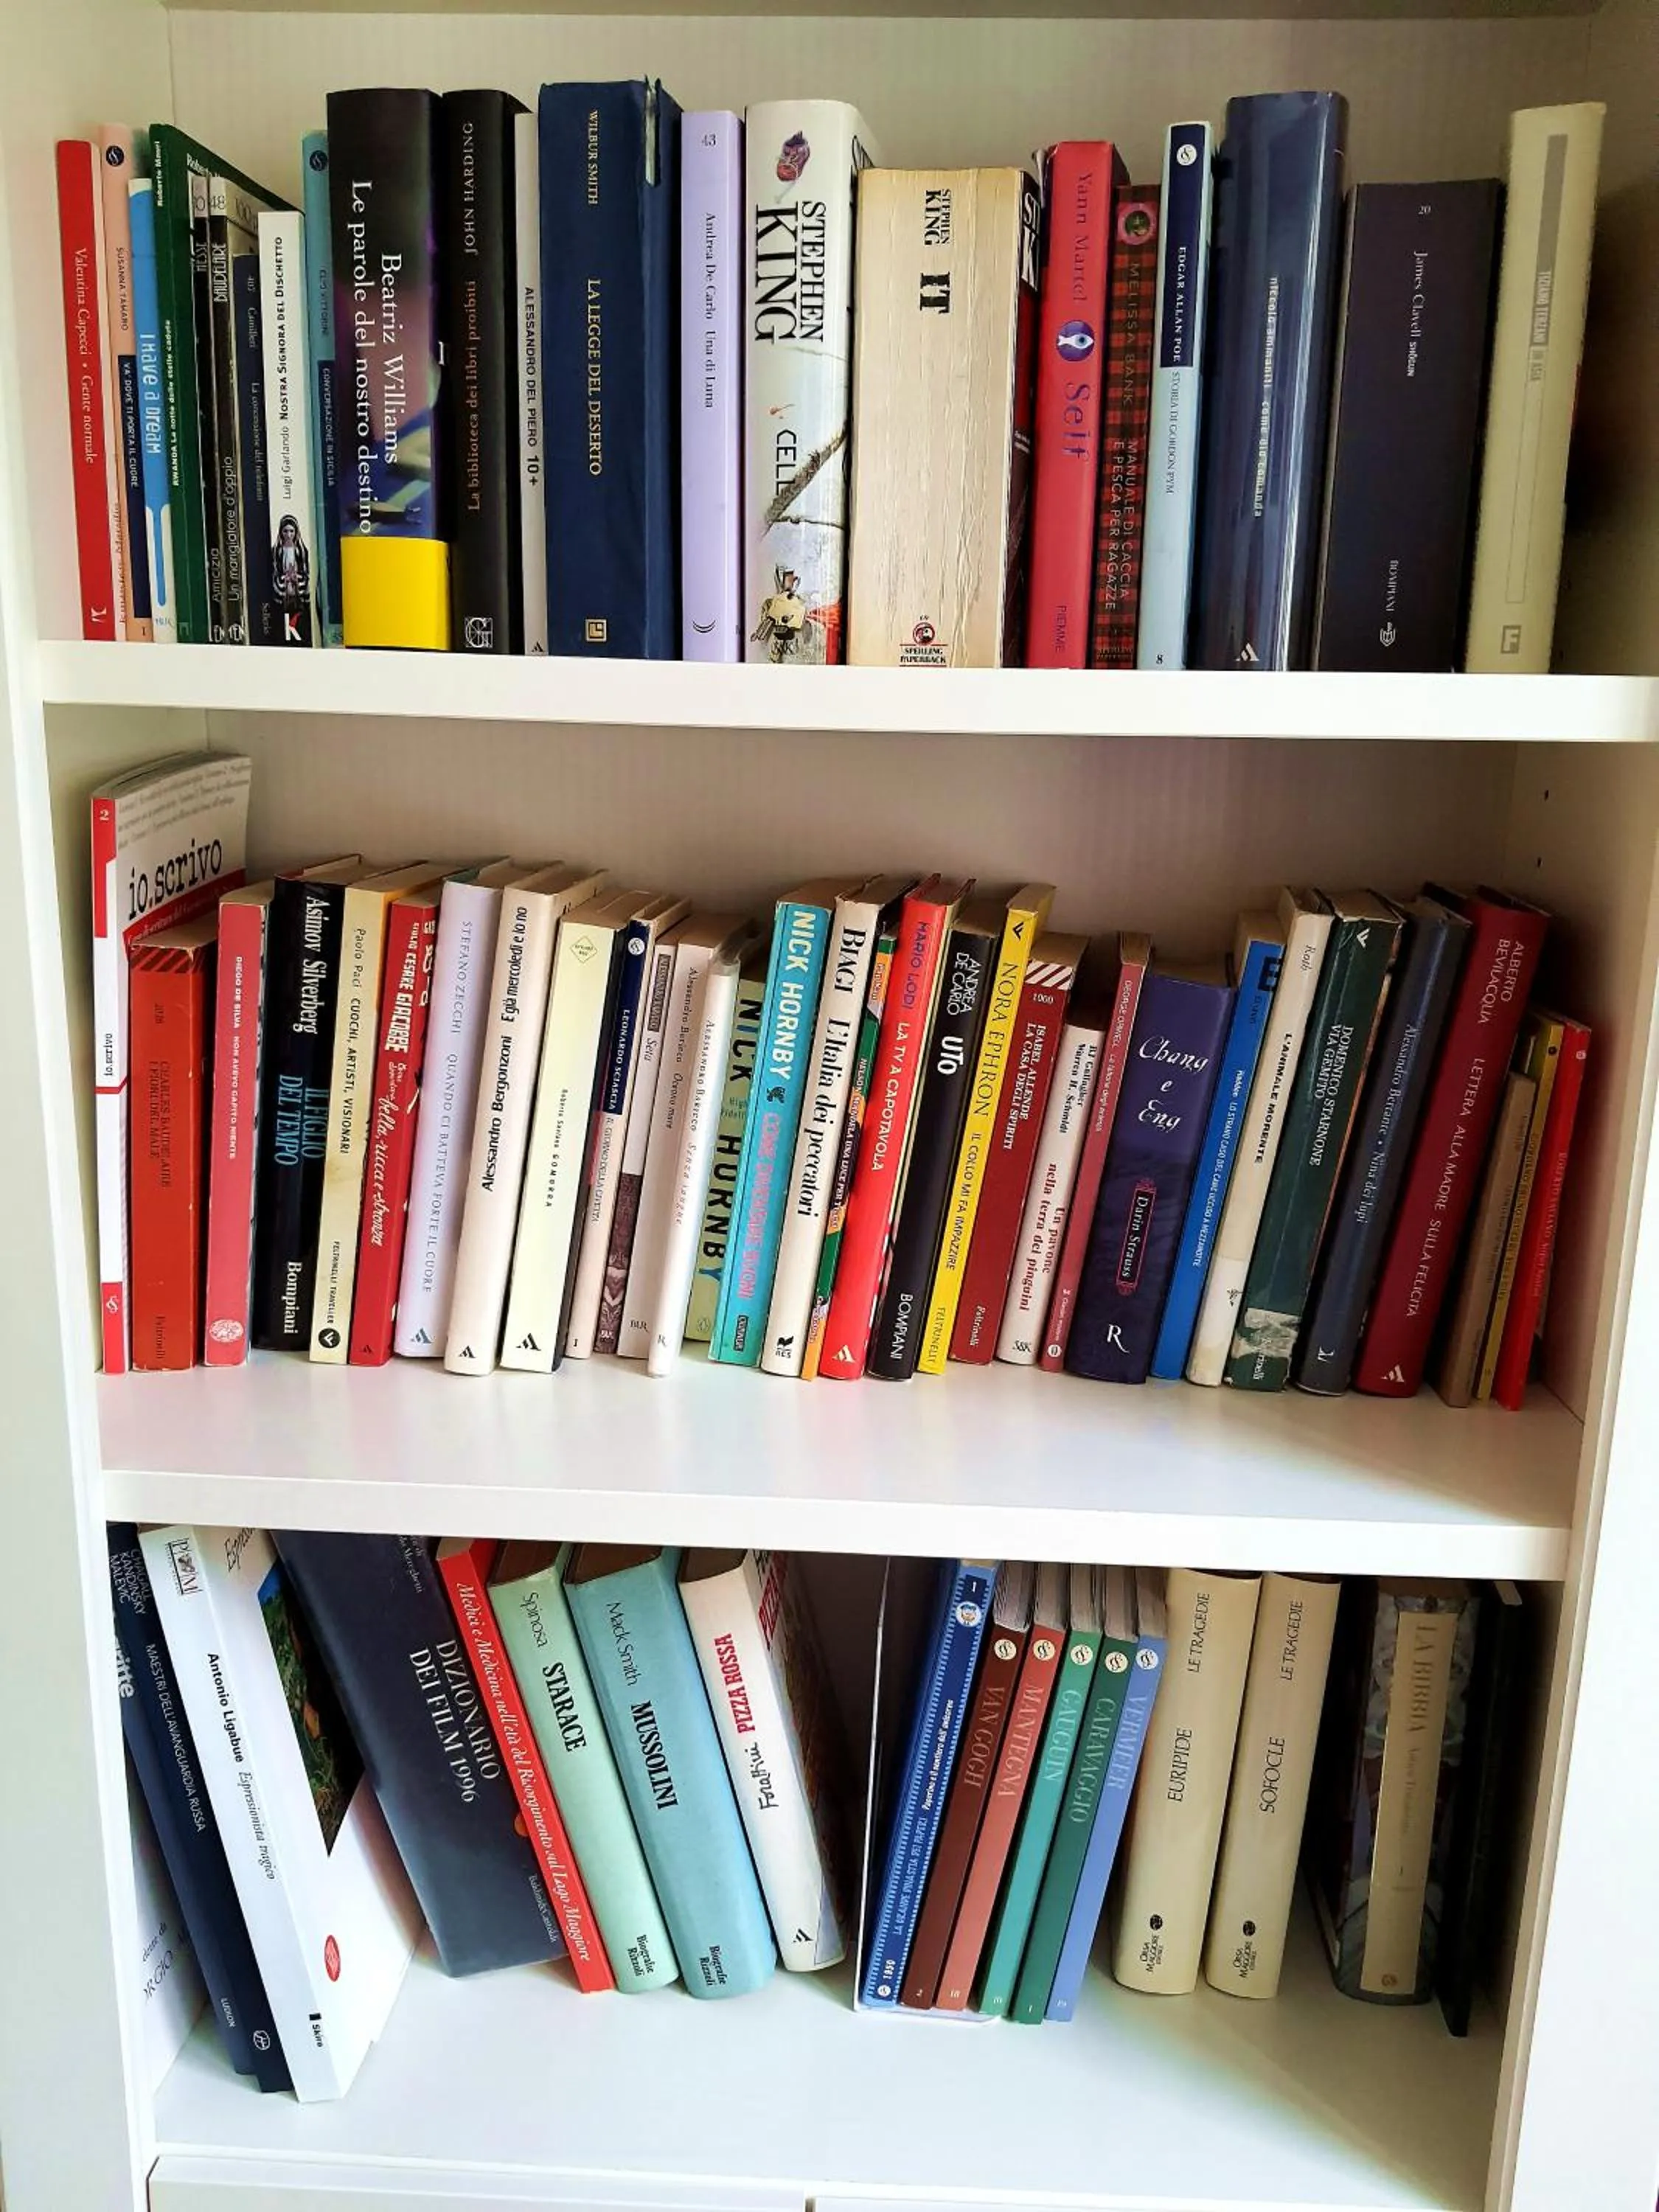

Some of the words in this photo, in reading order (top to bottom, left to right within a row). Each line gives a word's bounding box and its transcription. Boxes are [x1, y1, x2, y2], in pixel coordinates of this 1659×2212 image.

[588, 109, 599, 160] WILBUR
[462, 122, 476, 203] HARDING
[588, 162, 599, 206] SMITH
[351, 180, 372, 213] Le
[924, 189, 942, 246] KING
[940, 188, 953, 245] STEPHEN
[1075, 172, 1093, 225] Yann
[463, 207, 479, 256] JOHN
[705, 212, 717, 260] Andrea
[74, 248, 90, 305] Valentina
[116, 247, 125, 291] SUSANNA
[347, 222, 375, 302] parole
[705, 264, 717, 282] De
[754, 200, 799, 346] KING
[799, 200, 827, 344] STEPHEN
[1071, 235, 1090, 302] Martel
[1176, 246, 1188, 289] EDGAR
[1413, 251, 1428, 290] James
[380, 253, 404, 344] Beatriz
[465, 280, 481, 341] proibiti
[588, 278, 602, 301] LA
[705, 285, 717, 320] Carlo
[919, 271, 951, 315] IT
[1126, 262, 1141, 344] MELISSA
[1174, 294, 1186, 333] ALLAN
[1409, 293, 1425, 338] Clavell
[76, 308, 93, 355] Capecci
[276, 324, 288, 374] SIGNORA
[354, 310, 376, 347] del
[524, 287, 538, 375] ALESSANDRO
[588, 303, 602, 359] LEGGE
[1172, 338, 1183, 363] POE
[465, 347, 480, 381] libri
[588, 364, 602, 396] DEL
[1169, 370, 1181, 406] STORIA
[82, 375, 95, 411] Gente
[144, 391, 159, 401] a
[355, 358, 372, 437] nostro
[382, 353, 405, 465] Williams
[465, 384, 480, 408] dei
[526, 379, 537, 405] DEL
[83, 415, 99, 464] normale
[127, 417, 136, 446] PORTA
[526, 408, 538, 448] PIERO
[588, 400, 603, 476] DESERTO
[1062, 382, 1092, 464] Self
[171, 446, 179, 487] RWANDA
[466, 414, 481, 489] biblioteca
[526, 454, 540, 487] 10+
[775, 428, 798, 496] CELL
[1122, 441, 1138, 515] MANUALE
[356, 445, 378, 534] destino
[1110, 456, 1124, 504] PESCA
[1108, 509, 1121, 537] PER
[1121, 520, 1135, 537] DI
[210, 548, 223, 602] Amicizia
[227, 585, 240, 601] Un
[1105, 541, 1119, 611] RAGAZZE
[1119, 540, 1134, 599] CACCIA
[1384, 559, 1399, 612] BOMPIANI
[1054, 603, 1068, 653] PIEMME
[128, 837, 223, 922] io.scrivo
[303, 895, 330, 952] Asimov
[353, 928, 367, 959] Paolo
[784, 910, 816, 973] NICK
[911, 921, 931, 968] MARIO
[234, 956, 244, 986] DIEGO
[352, 964, 364, 988] Paci
[454, 919, 474, 982] STEFANO
[834, 926, 869, 994] BIAGI
[954, 951, 970, 970] DE
[1299, 944, 1318, 972] Roth
[1499, 941, 1525, 1003] ALBERTO
[292, 958, 329, 1034] Silverberg
[901, 973, 920, 1009] LODI
[945, 971, 967, 1016] CARLO
[959, 957, 982, 1014] ANDREA
[991, 961, 1019, 1022] NORA
[1477, 938, 1510, 1024] BEVILACQUA
[383, 992, 413, 1053] GIACOBBE
[451, 984, 465, 1034] ZECCHI
[769, 981, 804, 1081] HORNBY
[895, 1022, 912, 1041] LA
[1329, 1023, 1343, 1047] VIA
[616, 1008, 632, 1064] LEONARDO
[936, 1035, 964, 1075] UTO
[1019, 1040, 1033, 1071] CASA
[1137, 1035, 1210, 1076] Chang
[1327, 1026, 1354, 1096] DOMENICO
[1391, 1024, 1417, 1085] Alessandro
[277, 1074, 305, 1105] DEL
[304, 1086, 330, 1103] IL
[442, 1053, 459, 1111] QUANDO
[490, 1035, 514, 1113] Bergonzoni
[889, 1064, 902, 1074] A
[972, 1030, 1006, 1116] EPHRON
[1020, 1068, 1039, 1121] ALLENDE
[1161, 1079, 1173, 1093] e
[1314, 1047, 1336, 1100] GEMITO
[1459, 1058, 1485, 1116] LETTERA
[813, 1093, 838, 1124] dei
[871, 1078, 902, 1171] CAPOTAVOLA
[1137, 1099, 1181, 1134] Eng
[1221, 1112, 1237, 1139] STRANO
[1253, 1102, 1277, 1164] MORENTE
[1309, 1098, 1336, 1166] STARNONE
[274, 1108, 303, 1166] TEMPO
[434, 1133, 451, 1189] BATTEVA
[481, 1117, 503, 1192] Alessandro
[1448, 1124, 1467, 1160] ALLA
[545, 1154, 559, 1208] GOMORRA
[796, 1128, 827, 1217] peccatori
[960, 1183, 971, 1197] MI
[1433, 1162, 1457, 1211] MADRE
[429, 1193, 444, 1232] FORTE
[699, 1133, 743, 1284] HORNBY
[957, 1199, 970, 1213] FA
[1035, 1199, 1051, 1231] terra
[1131, 1195, 1151, 1231] Darin
[1042, 1228, 1062, 1274] pavone
[1120, 1235, 1141, 1279] Strauss
[1419, 1218, 1441, 1260] SULLA
[281, 1261, 304, 1334] Bompiani
[422, 1251, 437, 1293] CUORE
[889, 1293, 914, 1360] BOMPIANI
[926, 1307, 947, 1363] FELTRINELLI
[119, 1549, 146, 1615] KANDINSKY
[473, 1638, 504, 1697] Medicina
[519, 1591, 550, 1649] Spinosa
[541, 1660, 588, 1753] STARACE
[713, 1633, 744, 1685] ROSSA
[435, 1638, 503, 1780] DIZIONARIO
[606, 1601, 630, 1641] Mack
[618, 1644, 642, 1687] Smith
[630, 1699, 680, 1811] MUSSOLINI
[730, 1688, 756, 1735] PIZZA
[978, 1686, 1005, 1726] VAN
[1167, 1726, 1193, 1802] EURIPIDE
[1188, 1591, 1211, 1656] TRAGEDIE
[1259, 1736, 1286, 1814] SOFOCLE
[1281, 1601, 1304, 1664] TRAGEDIE
[1407, 1659, 1435, 1734] BIBBIA
[145, 1644, 168, 1691] MAESTRI
[187, 1797, 208, 1832] RUSSA
[408, 1647, 442, 1690] DEI
[425, 1694, 465, 1753] FILM
[449, 1757, 481, 1804] 1996
[996, 1683, 1045, 1798] MANTEGNA
[1041, 1688, 1082, 1783] GAUGUIN
[1106, 1695, 1149, 1790] VERMEER
[206, 1652, 231, 1707] Antonio
[222, 1710, 246, 1764] Ligabue
[255, 1843, 278, 1880] tragico
[961, 1728, 994, 1788] GOGH
[1068, 1697, 1117, 1824] CARAVAGGIO
[551, 1871, 576, 1903] Lago
[560, 1904, 591, 1961] Maggiore
[311, 2023, 325, 2048] Skira
